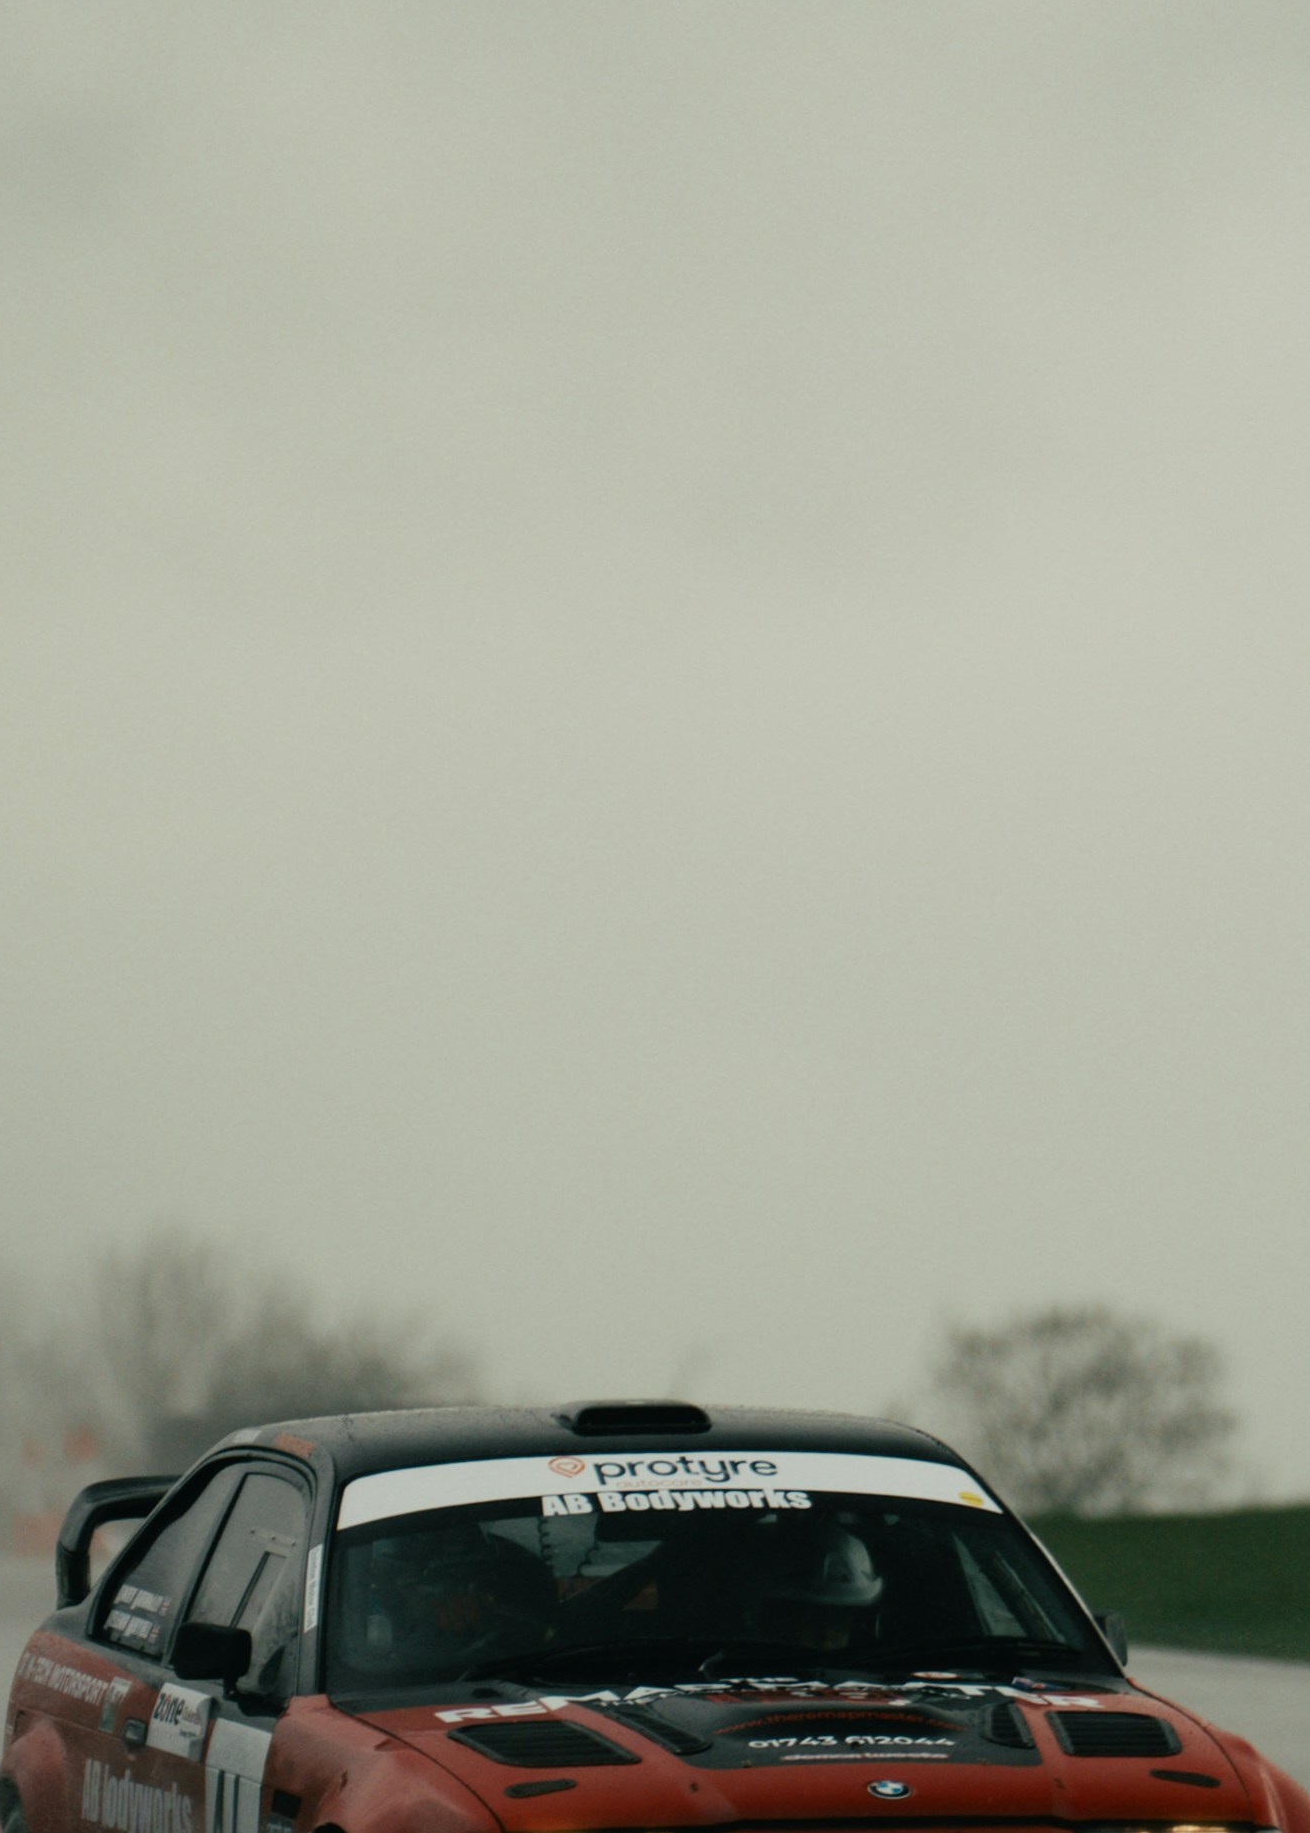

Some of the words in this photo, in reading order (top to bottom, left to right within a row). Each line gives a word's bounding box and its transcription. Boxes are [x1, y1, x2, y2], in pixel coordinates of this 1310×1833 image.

[593, 1456, 778, 1485] protyre
[616, 1479, 702, 1488] autocare
[542, 1493, 593, 1517] AB
[596, 1489, 813, 1513] Bodyworks
[153, 1693, 185, 1726] zone
[748, 1735, 838, 1749] 01743
[844, 1734, 956, 1747] 612044
[81, 1758, 102, 1822] AB
